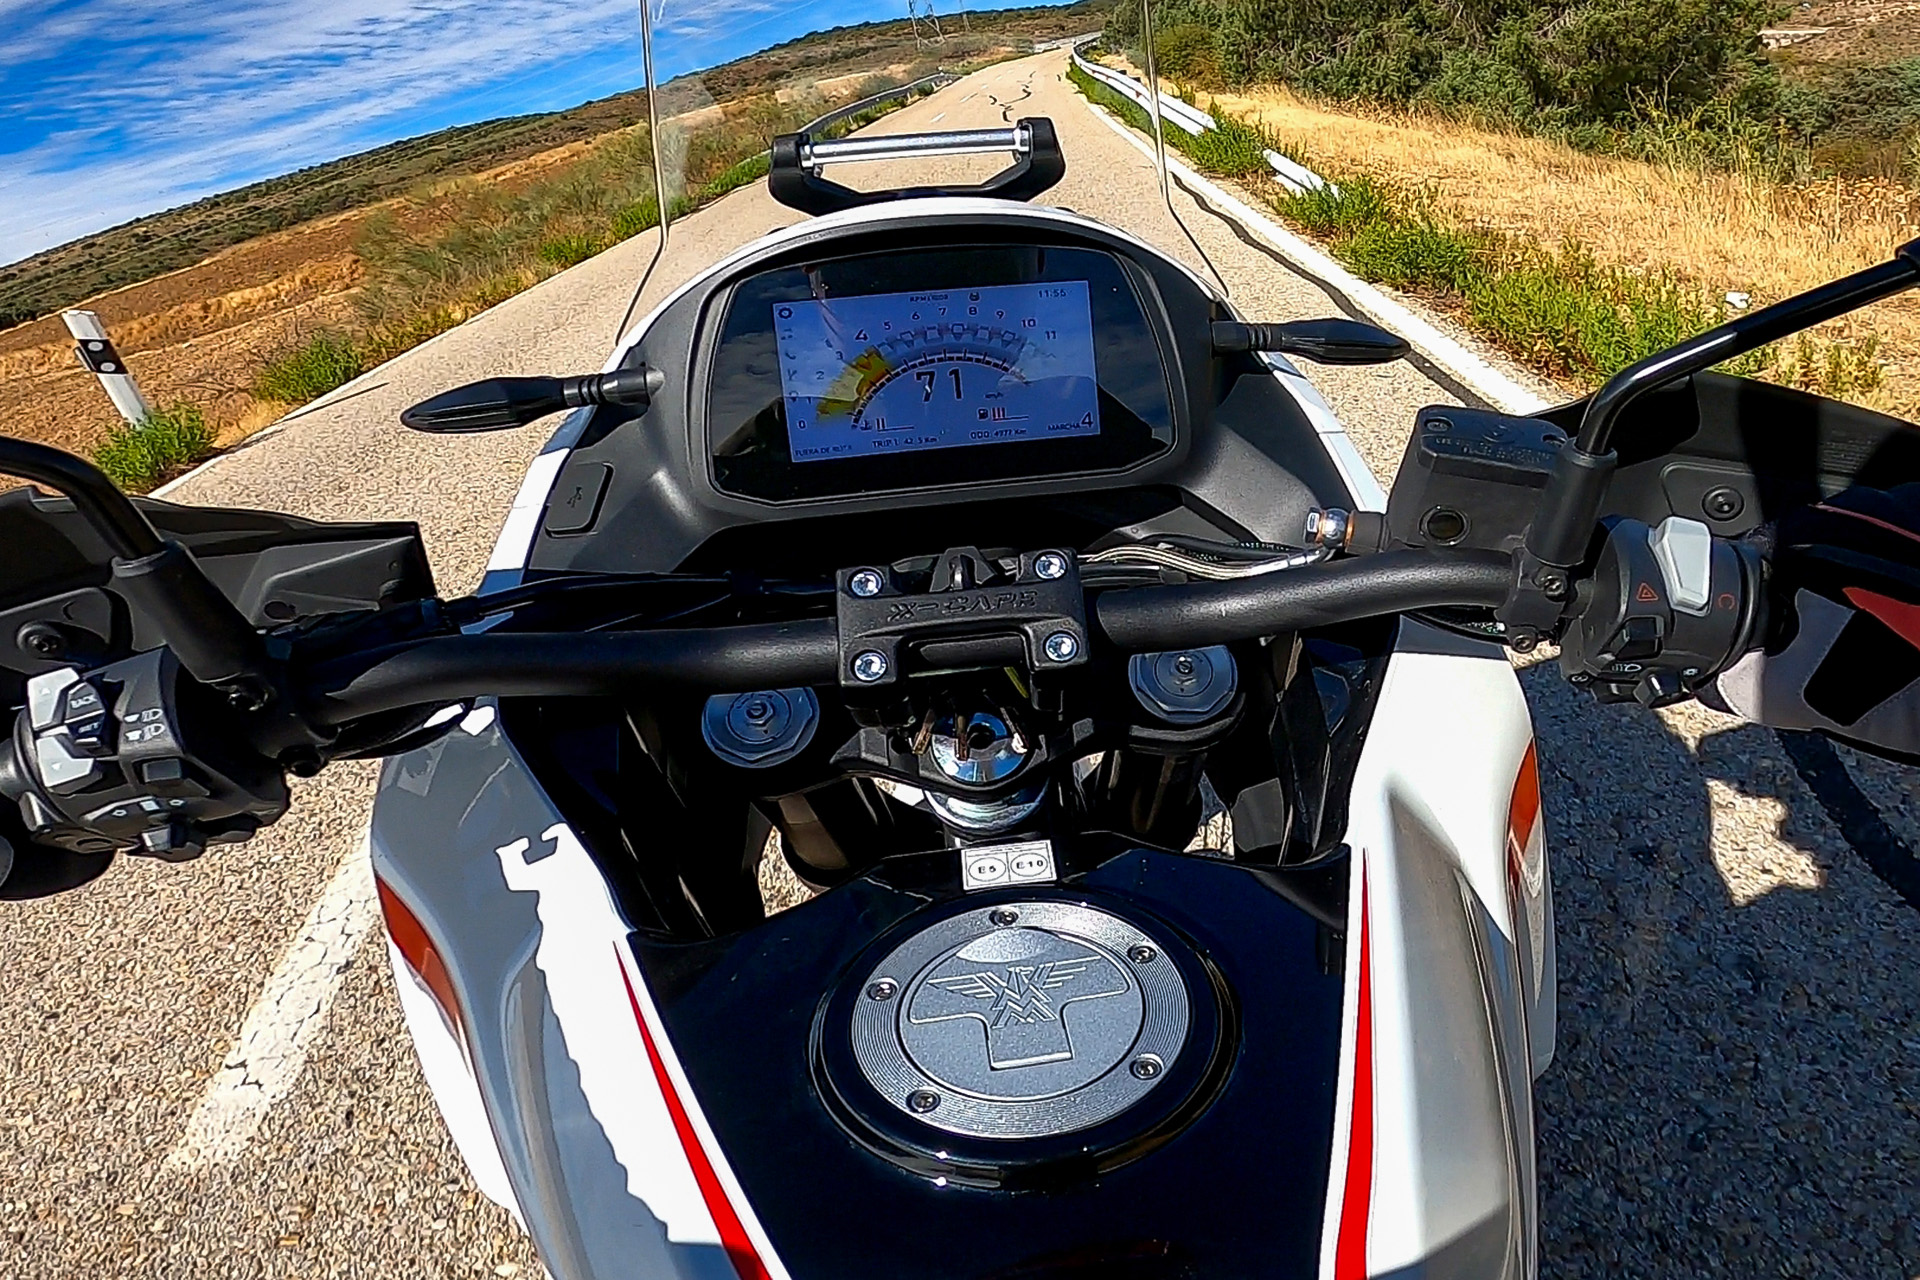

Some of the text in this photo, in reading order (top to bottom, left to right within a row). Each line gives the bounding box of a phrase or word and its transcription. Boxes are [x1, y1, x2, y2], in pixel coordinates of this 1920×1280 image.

[911, 311, 920, 321] 6
[938, 307, 947, 316] 7
[968, 306, 978, 316] 8
[996, 310, 1005, 319] 9
[883, 321, 892, 331] 5
[1021, 319, 1037, 328] 10
[854, 329, 869, 342] 4
[1044, 330, 1057, 340] 11
[835, 350, 844, 361] 3
[815, 370, 825, 381] 2
[915, 367, 964, 403] 71
[798, 420, 807, 430] 0
[1048, 411, 1094, 432] MARCHA 4
[887, 590, 1038, 623] X-CAPE
[1016, 860, 1044, 869] E10
[978, 865, 997, 875] E5
